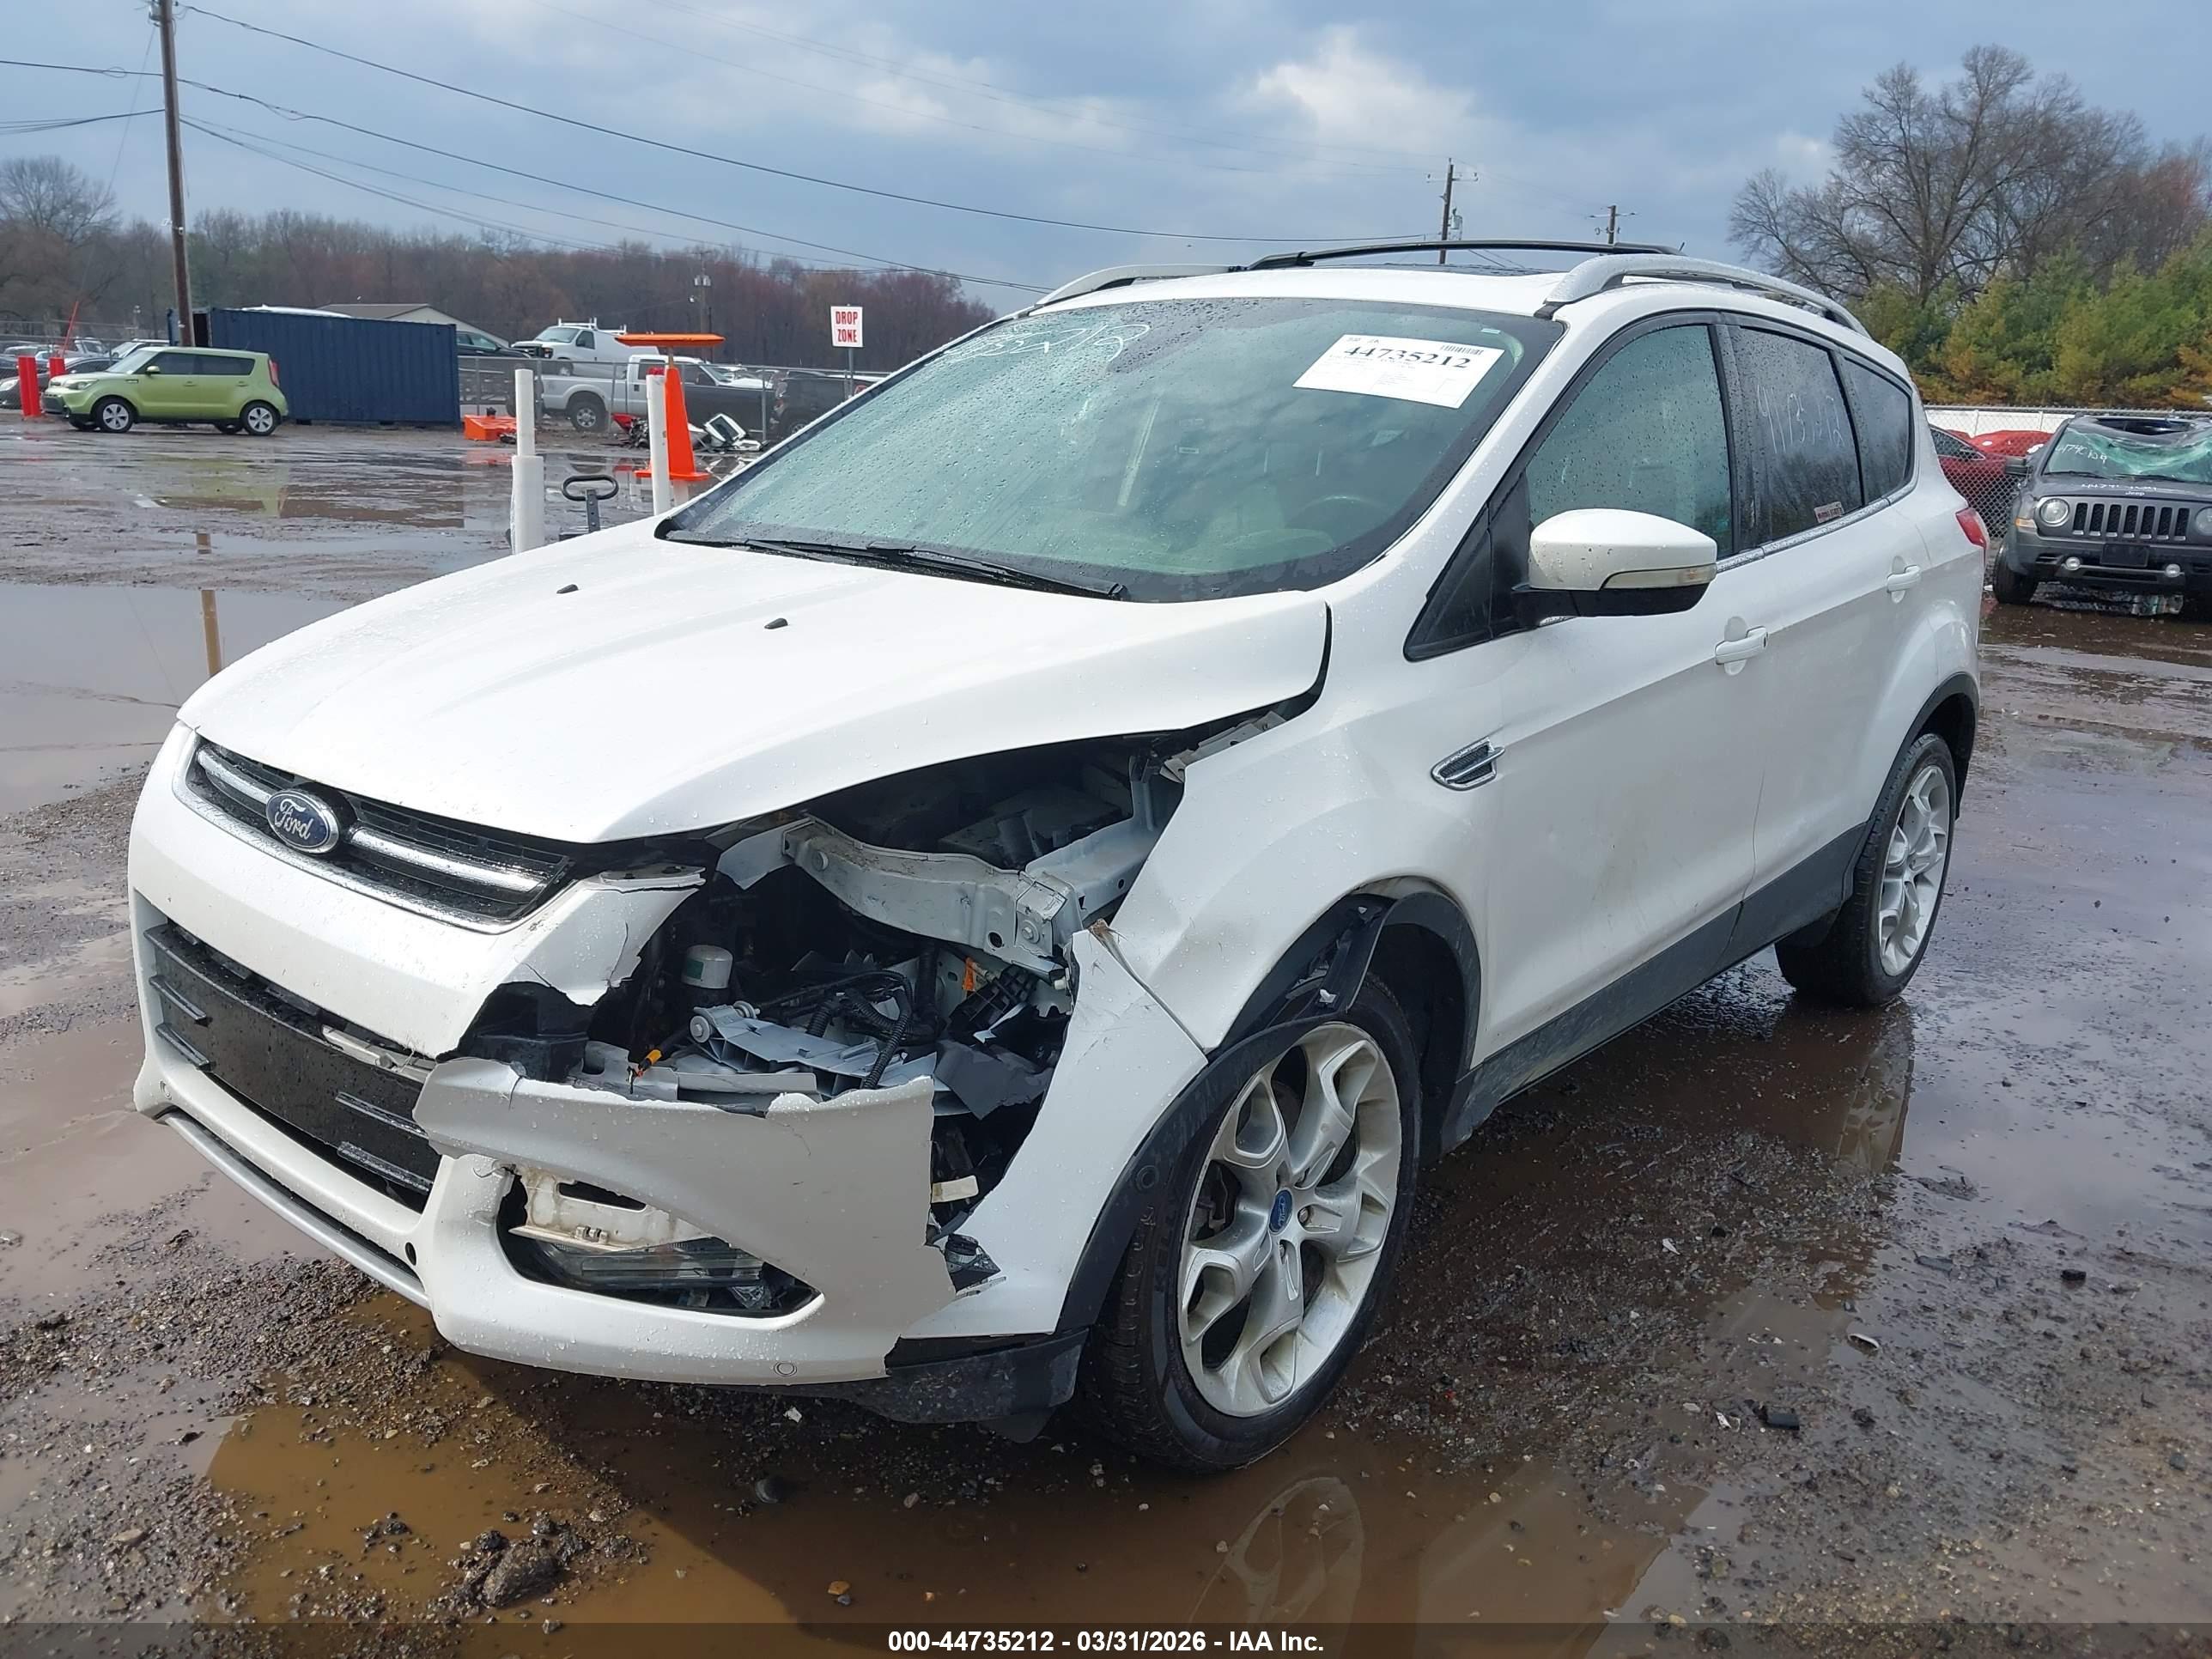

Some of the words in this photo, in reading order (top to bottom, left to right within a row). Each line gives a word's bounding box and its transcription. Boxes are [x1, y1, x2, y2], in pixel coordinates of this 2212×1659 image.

[836, 311, 858, 325] DROP
[837, 329, 857, 343] ZONE
[1344, 346, 1471, 368] 44735212
[274, 798, 314, 840] Ford
